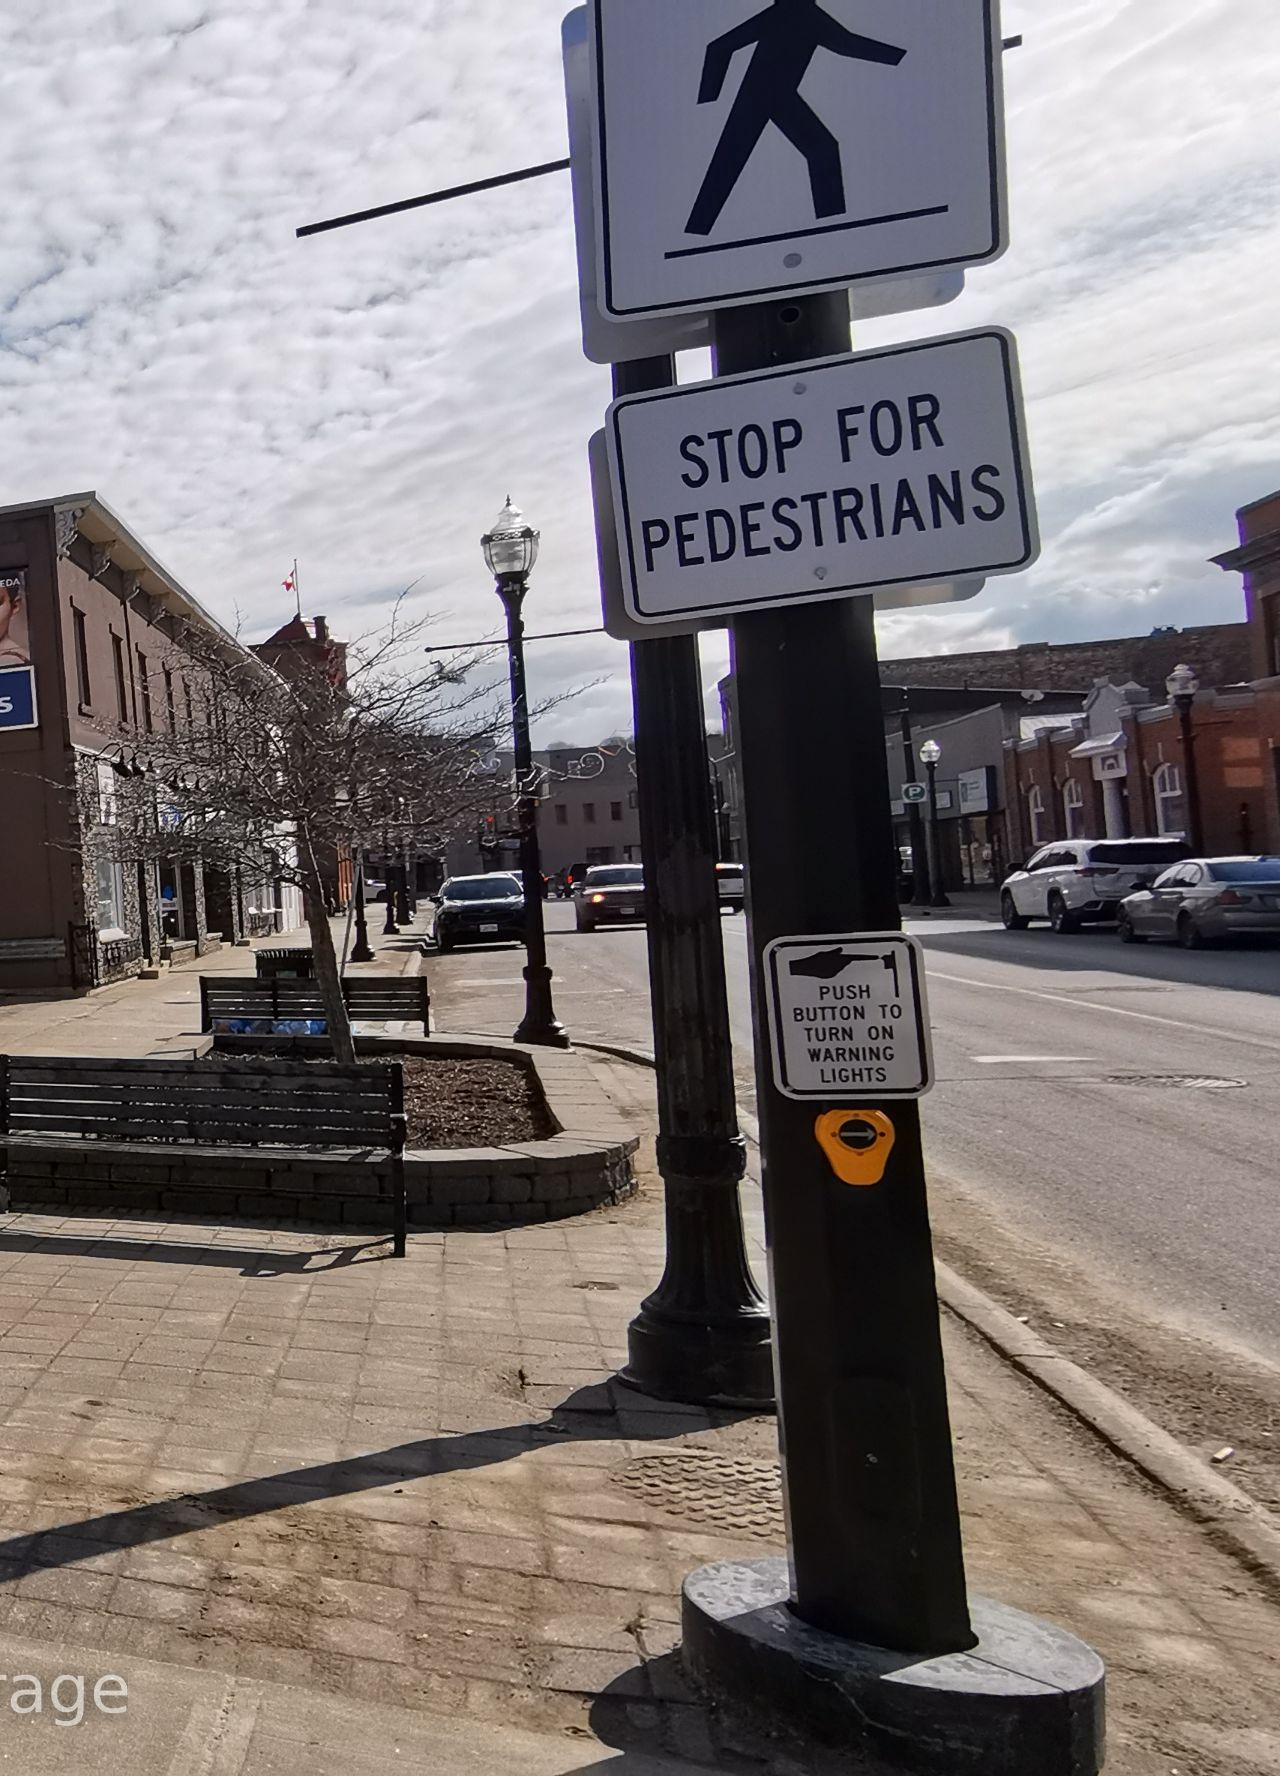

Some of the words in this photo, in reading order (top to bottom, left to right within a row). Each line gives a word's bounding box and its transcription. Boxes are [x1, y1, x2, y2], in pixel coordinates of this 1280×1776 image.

[679, 418, 803, 490] STOP
[837, 393, 944, 463] FOR
[641, 464, 1006, 573] PEDESTRIANS
[819, 984, 871, 1001] PUSH
[793, 1005, 866, 1022] BUTTON
[878, 1004, 903, 1019] TO
[804, 1026, 854, 1043] TURN
[867, 1025, 895, 1041] ON
[807, 1046, 895, 1063] WARNING
[820, 1067, 887, 1084] LIGHTS
